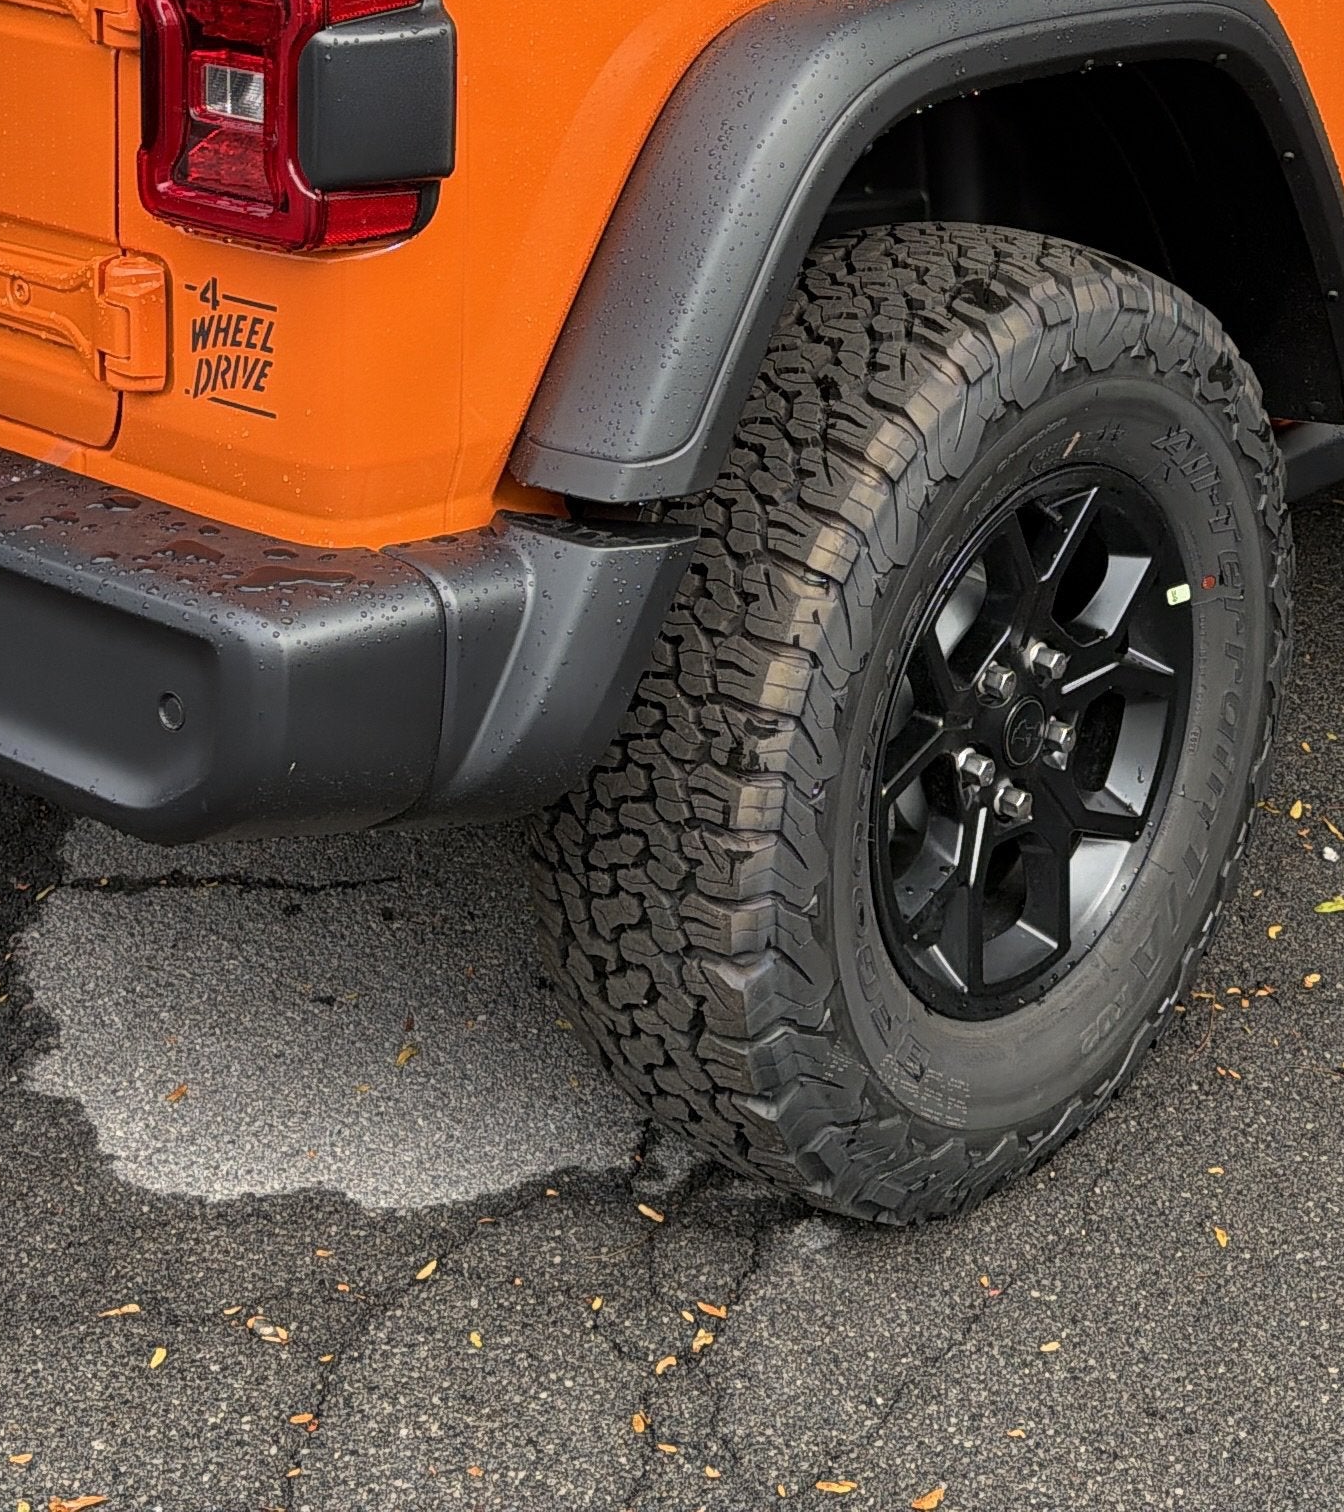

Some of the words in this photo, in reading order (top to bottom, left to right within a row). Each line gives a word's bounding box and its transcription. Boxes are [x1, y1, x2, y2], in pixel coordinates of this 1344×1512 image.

[199, 276, 221, 312] 4
[191, 314, 277, 354] WHEEL
[192, 354, 275, 400] DRIVE
